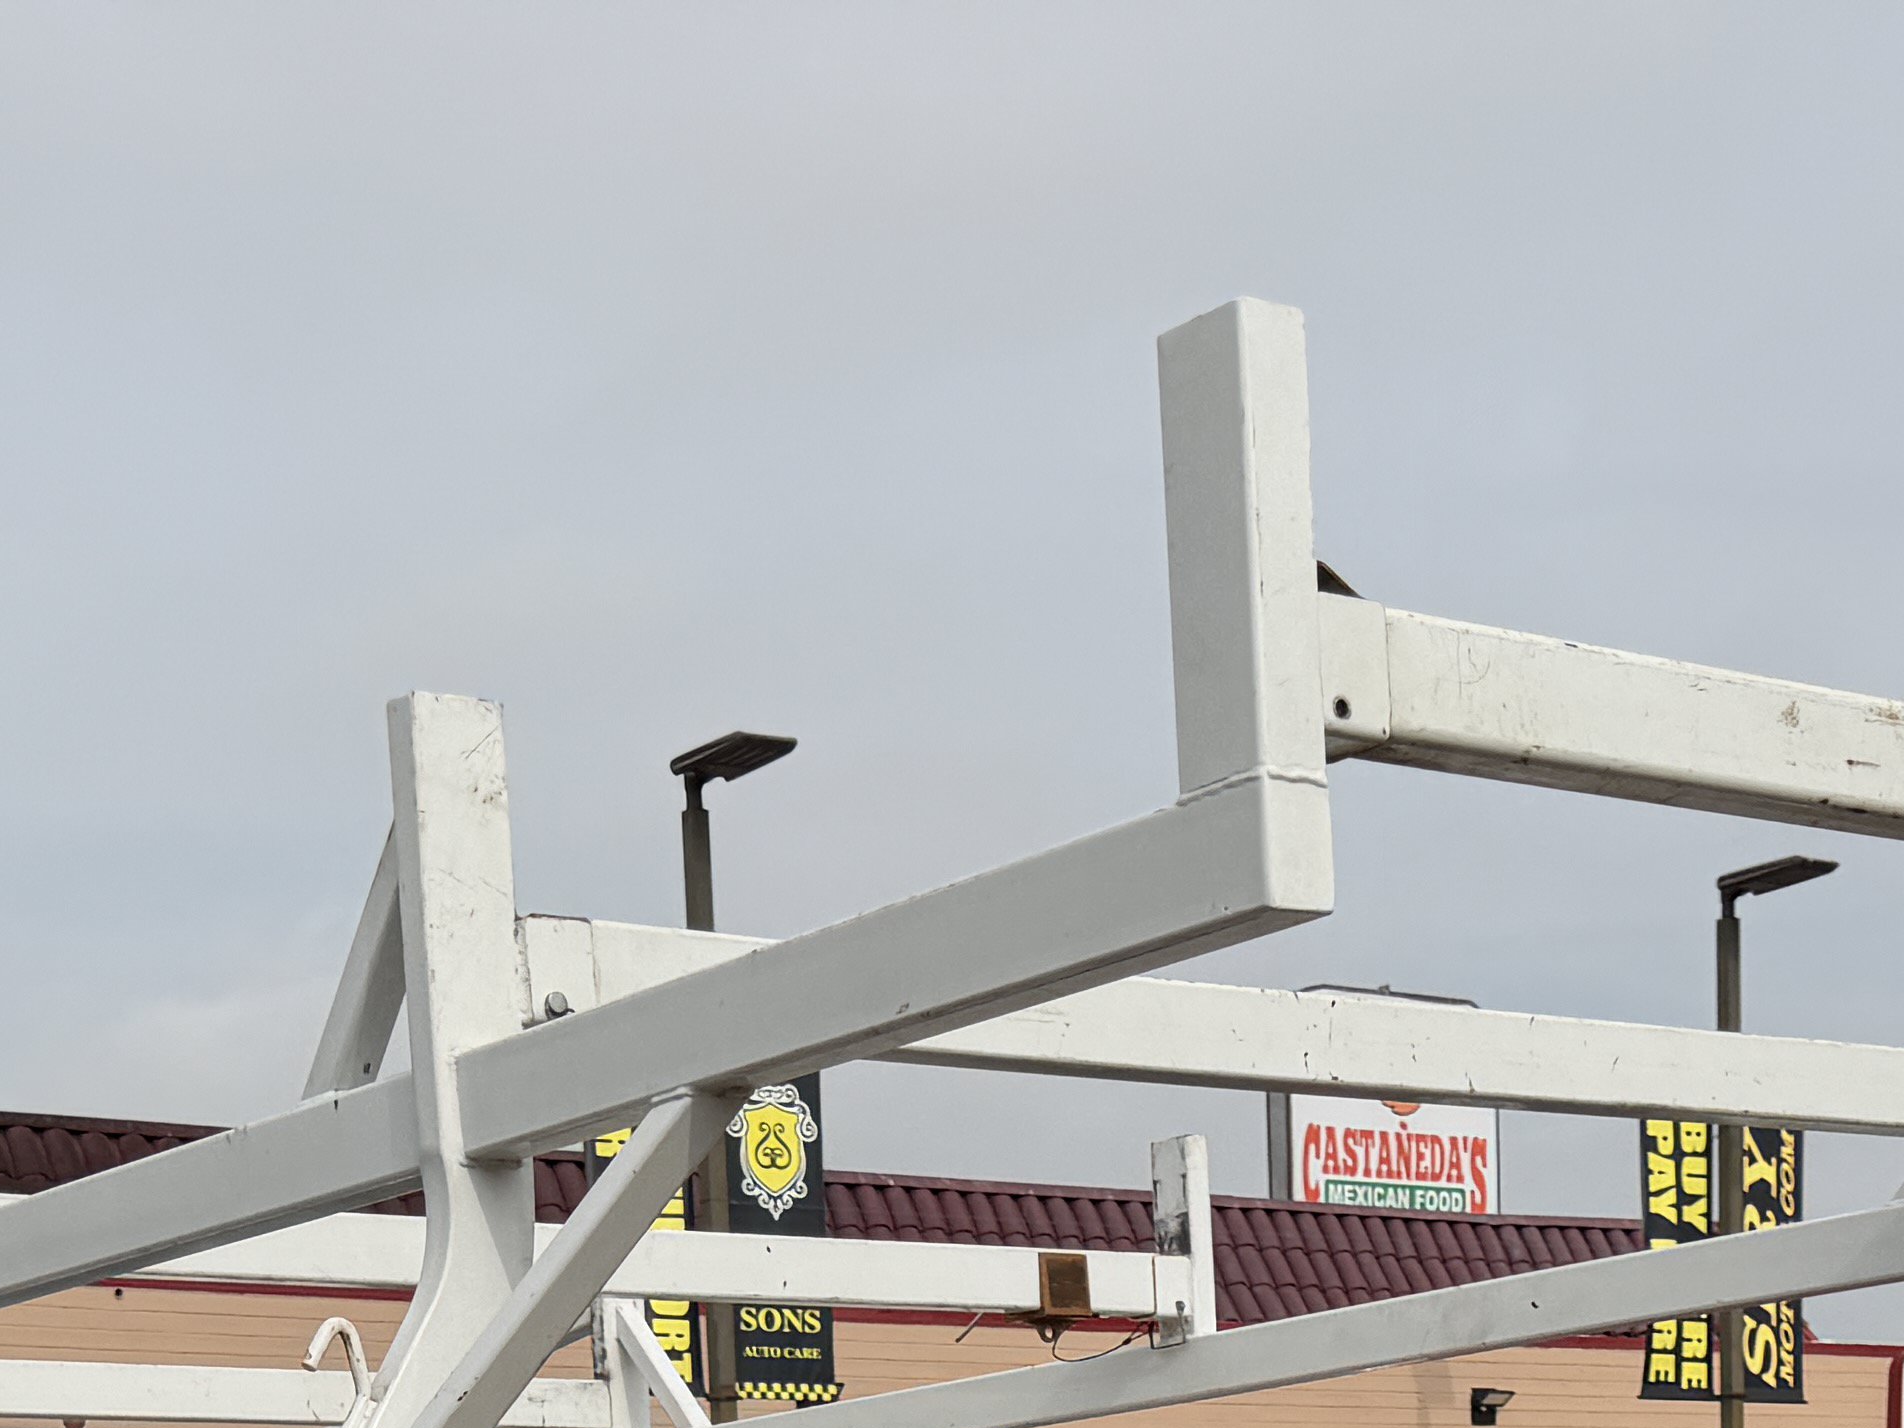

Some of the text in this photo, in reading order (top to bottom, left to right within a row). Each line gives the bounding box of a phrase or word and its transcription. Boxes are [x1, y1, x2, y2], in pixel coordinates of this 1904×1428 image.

[1646, 1119, 1678, 1226] PAY
[1680, 1122, 1708, 1236] BUY
[1328, 1183, 1464, 1213] MEXICAN FOOD
[739, 1306, 822, 1333] SONS
[743, 1346, 822, 1360] AUTO CARE
